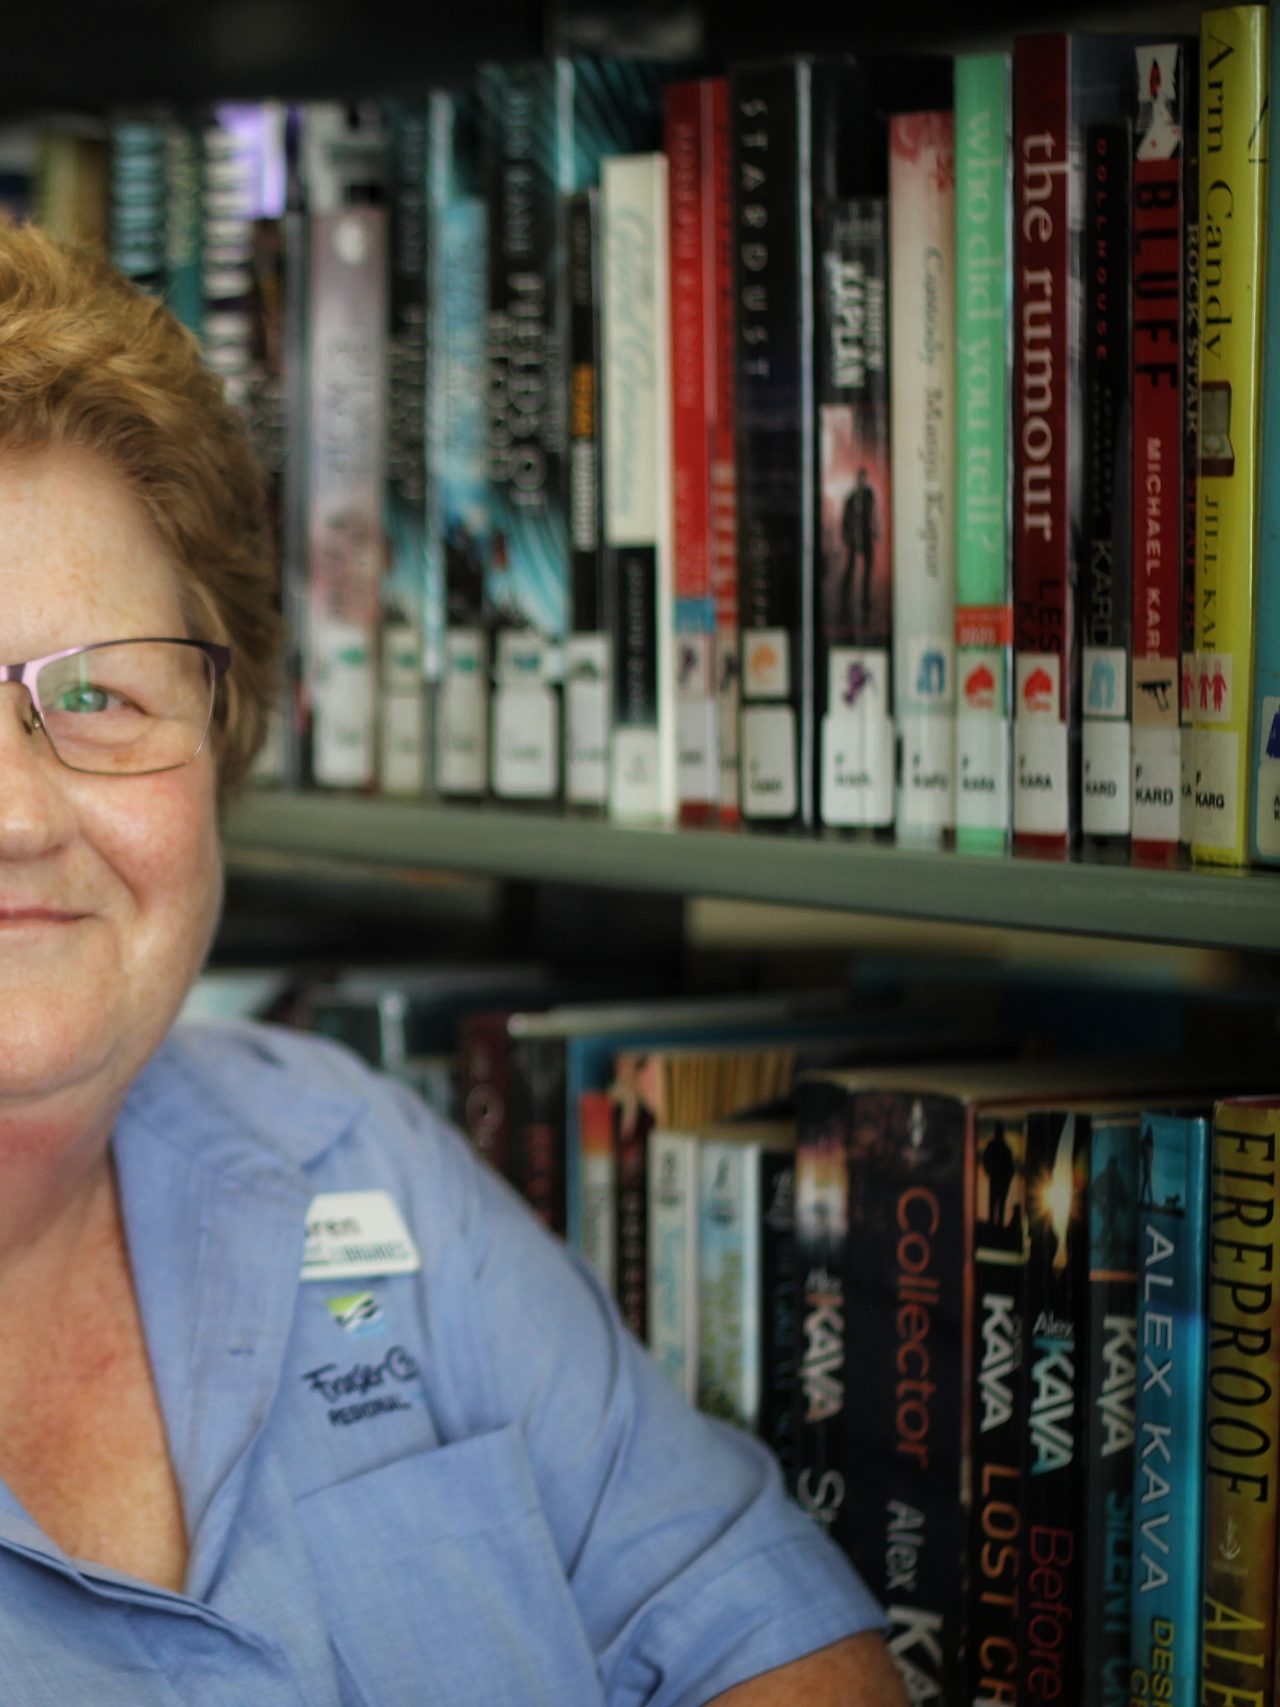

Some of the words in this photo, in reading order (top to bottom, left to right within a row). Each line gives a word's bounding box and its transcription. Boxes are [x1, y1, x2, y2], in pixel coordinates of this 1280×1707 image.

[1207, 32, 1235, 154] Arm
[967, 108, 1005, 222] who
[1022, 131, 1069, 243] the
[739, 98, 770, 378] STARDUST
[967, 232, 1005, 321] did
[1094, 135, 1112, 363] DOLLHOUSE
[1134, 181, 1180, 389] BLUFF
[1203, 180, 1236, 362] Candy
[961, 332, 993, 430] you
[1022, 269, 1055, 541] rumour
[1144, 437, 1162, 577] MICHAEL
[1205, 495, 1219, 575] JILL
[1135, 786, 1174, 806] KARD
[800, 1289, 846, 1424] KAVA
[896, 1186, 939, 1469] Collector
[978, 1292, 1016, 1433] KAVA
[1033, 1311, 1074, 1338] Alex
[1141, 1224, 1175, 1398] ALEX
[1208, 1130, 1275, 1502] FIREPROOF
[1028, 1337, 1075, 1476] KAVA
[1097, 1315, 1136, 1457] KAVA
[886, 1500, 926, 1592] Alex
[981, 1464, 1021, 1620] LOST
[1140, 1423, 1172, 1593] KAVA
[1028, 1525, 1074, 1699] Before
